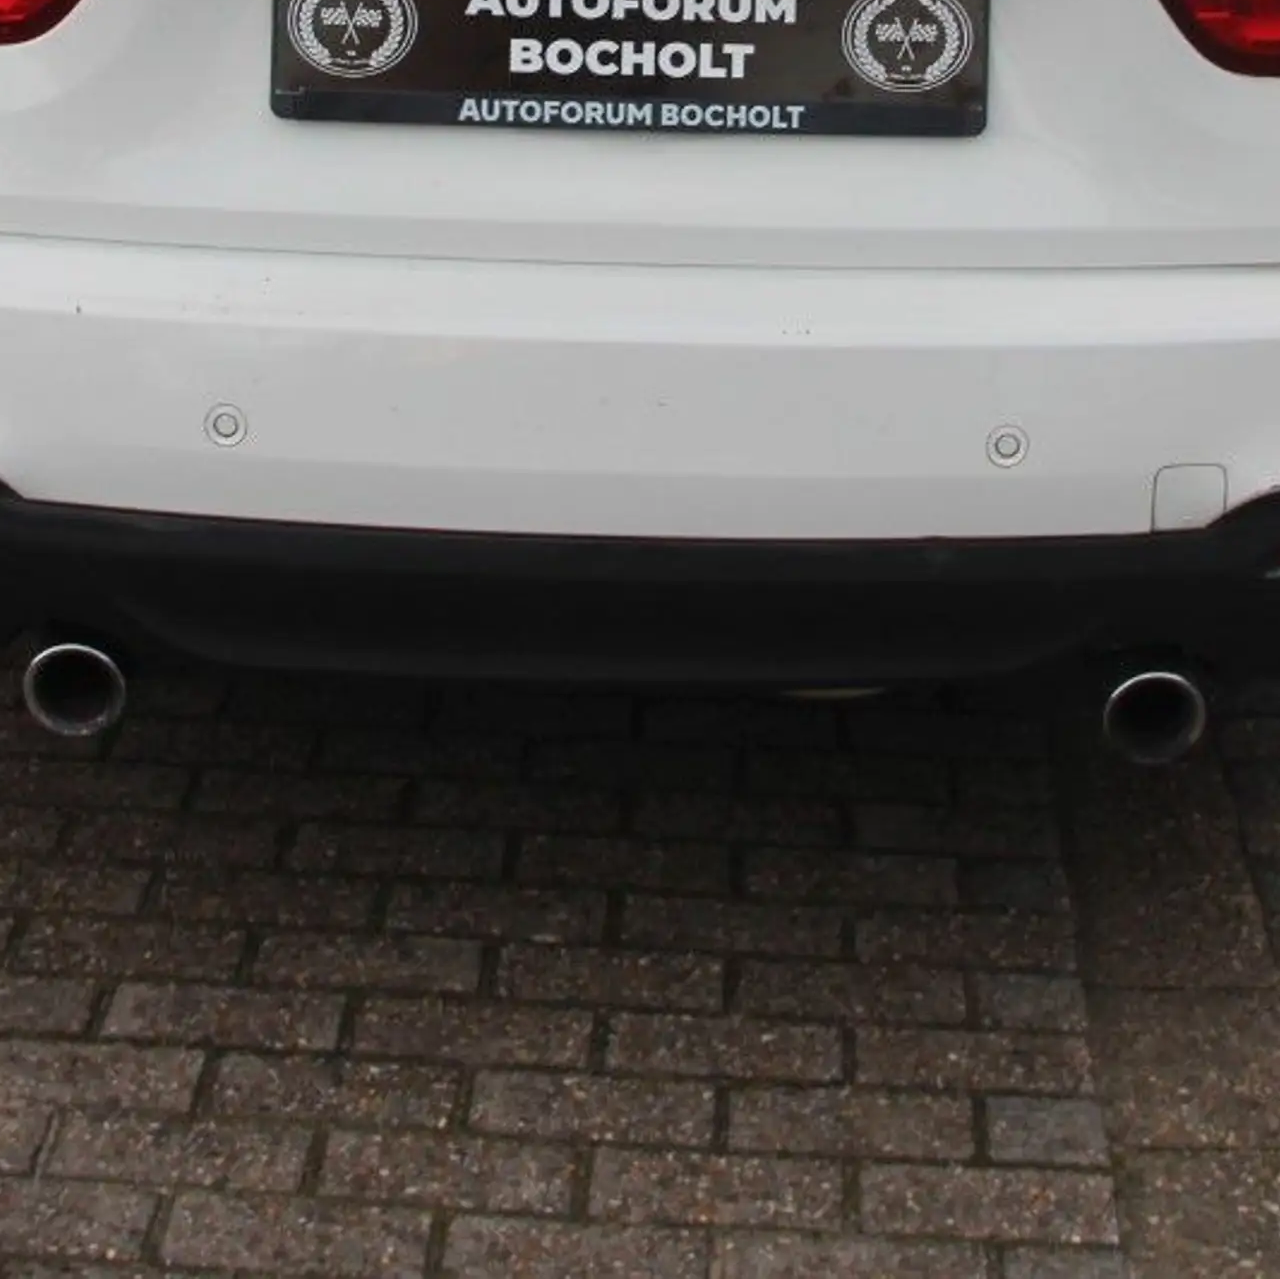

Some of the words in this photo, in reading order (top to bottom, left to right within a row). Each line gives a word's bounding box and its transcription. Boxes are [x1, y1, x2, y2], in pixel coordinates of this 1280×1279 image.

[508, 38, 756, 79] BOCHOLT
[458, 98, 653, 126] AUTOFORUM
[661, 103, 805, 129] BOCHOLT
